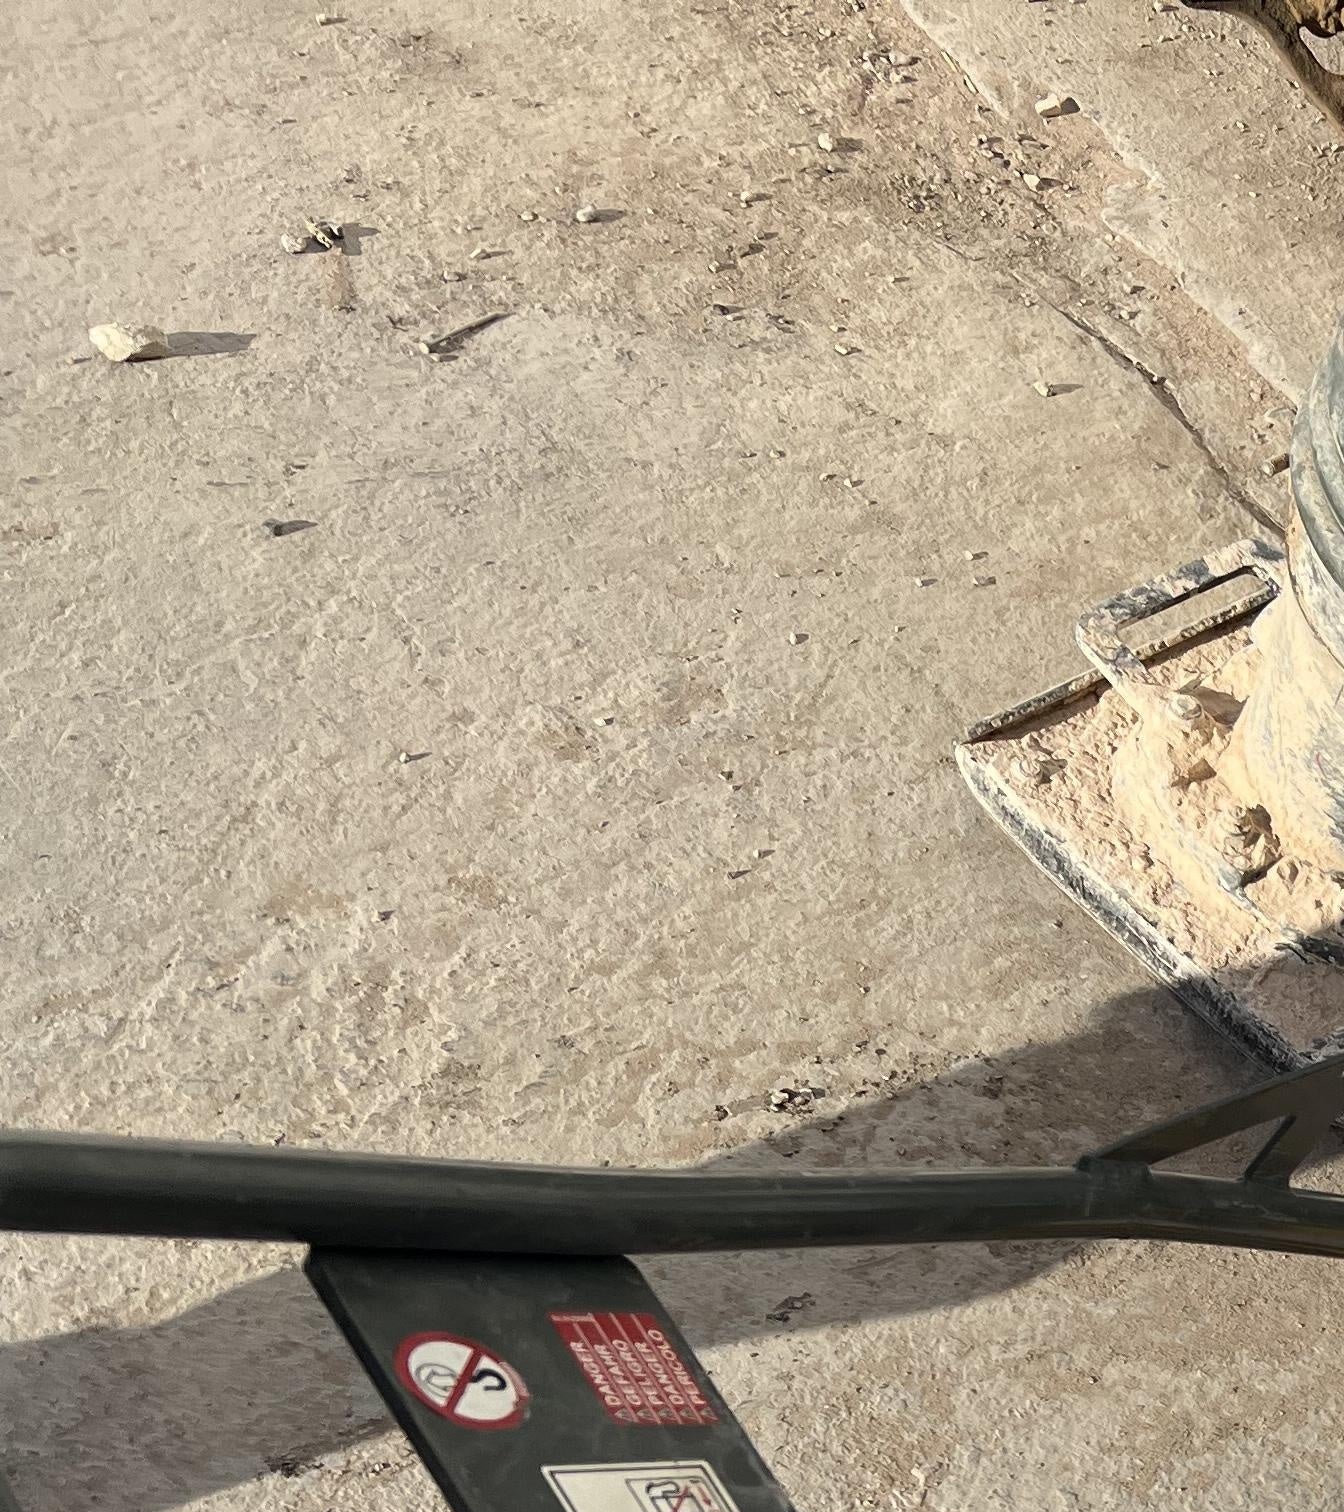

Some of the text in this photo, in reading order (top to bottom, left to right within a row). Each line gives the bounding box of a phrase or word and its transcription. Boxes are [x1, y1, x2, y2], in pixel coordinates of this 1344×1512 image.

[569, 1341, 619, 1406] DANGER
[593, 1343, 641, 1405] GEFAHR
[611, 1339, 663, 1404] PELIGRO
[634, 1341, 684, 1404] DANGER
[647, 1328, 705, 1404] PERICOLO
